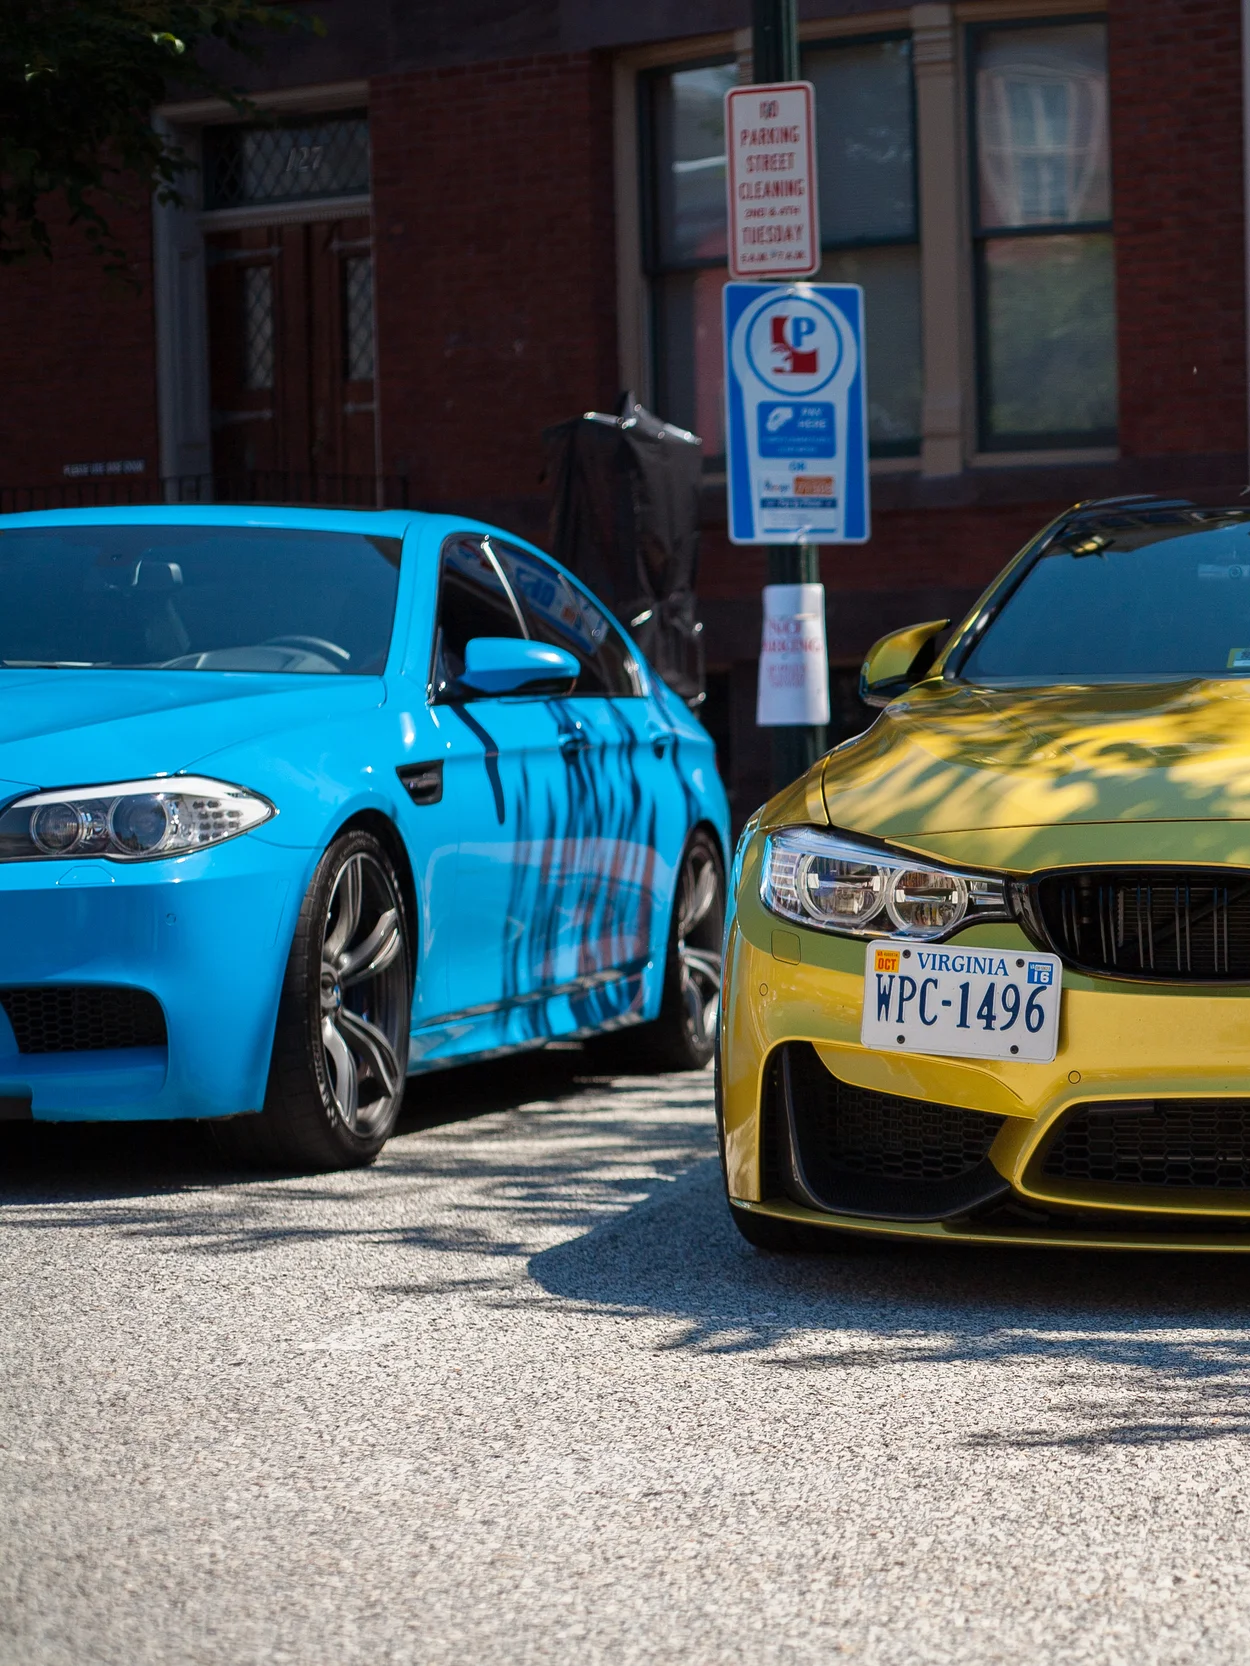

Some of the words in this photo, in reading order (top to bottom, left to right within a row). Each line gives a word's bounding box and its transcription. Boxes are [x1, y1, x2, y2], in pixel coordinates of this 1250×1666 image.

[740, 125, 800, 147] PARKING
[286, 146, 323, 172] 127
[746, 152, 795, 173] STREET
[738, 178, 804, 201] CLEANING
[742, 224, 804, 245] TUESDAY
[791, 316, 816, 348] P
[878, 957, 897, 970] OCT
[917, 952, 1010, 977] VIRGINIA
[1033, 970, 1050, 983] 16
[875, 973, 1048, 1033] WPC-1496
